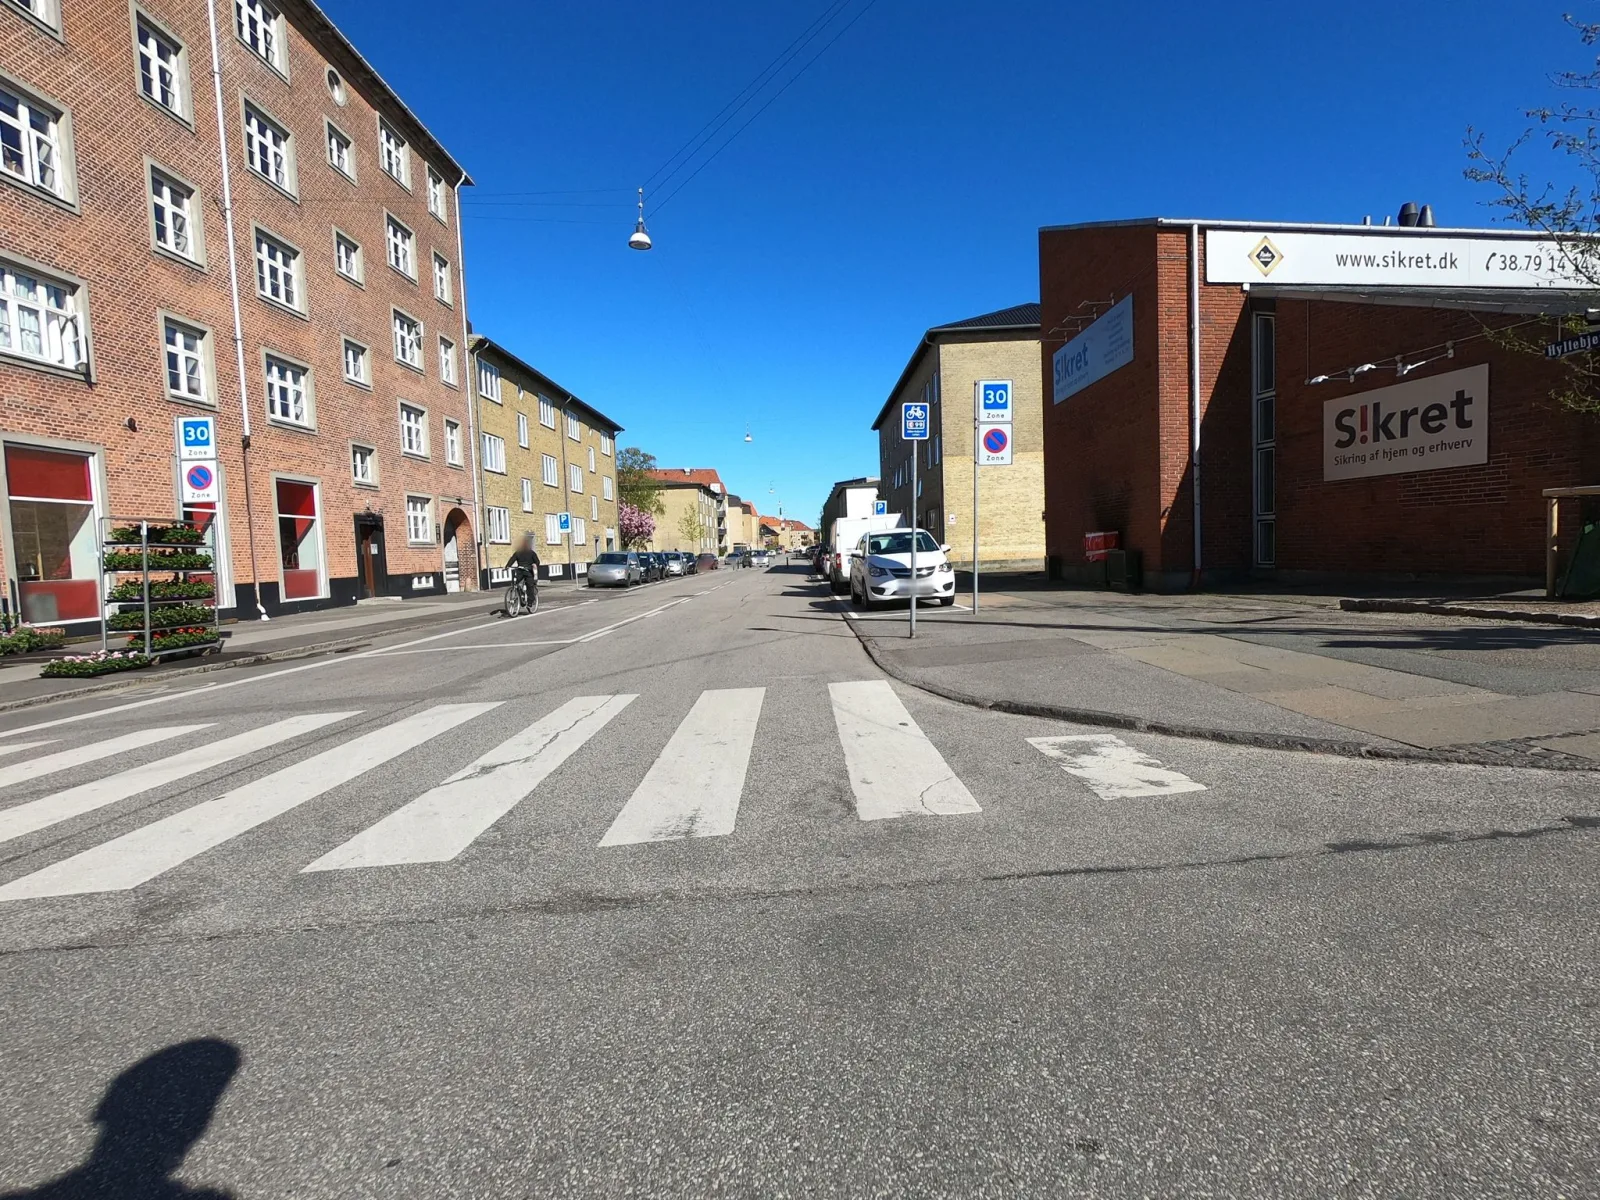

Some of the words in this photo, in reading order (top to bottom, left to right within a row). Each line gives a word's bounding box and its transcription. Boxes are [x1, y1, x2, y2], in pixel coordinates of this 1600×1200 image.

[1335, 250, 1458, 269] www.sikret.dk
[1548, 335, 1600, 357] Hyllebje
[985, 389, 1007, 404] 30
[185, 426, 208, 441] 30
[1334, 453, 1367, 466] Sikring
[1369, 450, 1380, 461] af
[1382, 447, 1408, 462] hjem
[1412, 445, 1425, 457] og
[1429, 438, 1473, 453] erhverv
[877, 503, 884, 511] P
[561, 515, 568, 523] P
